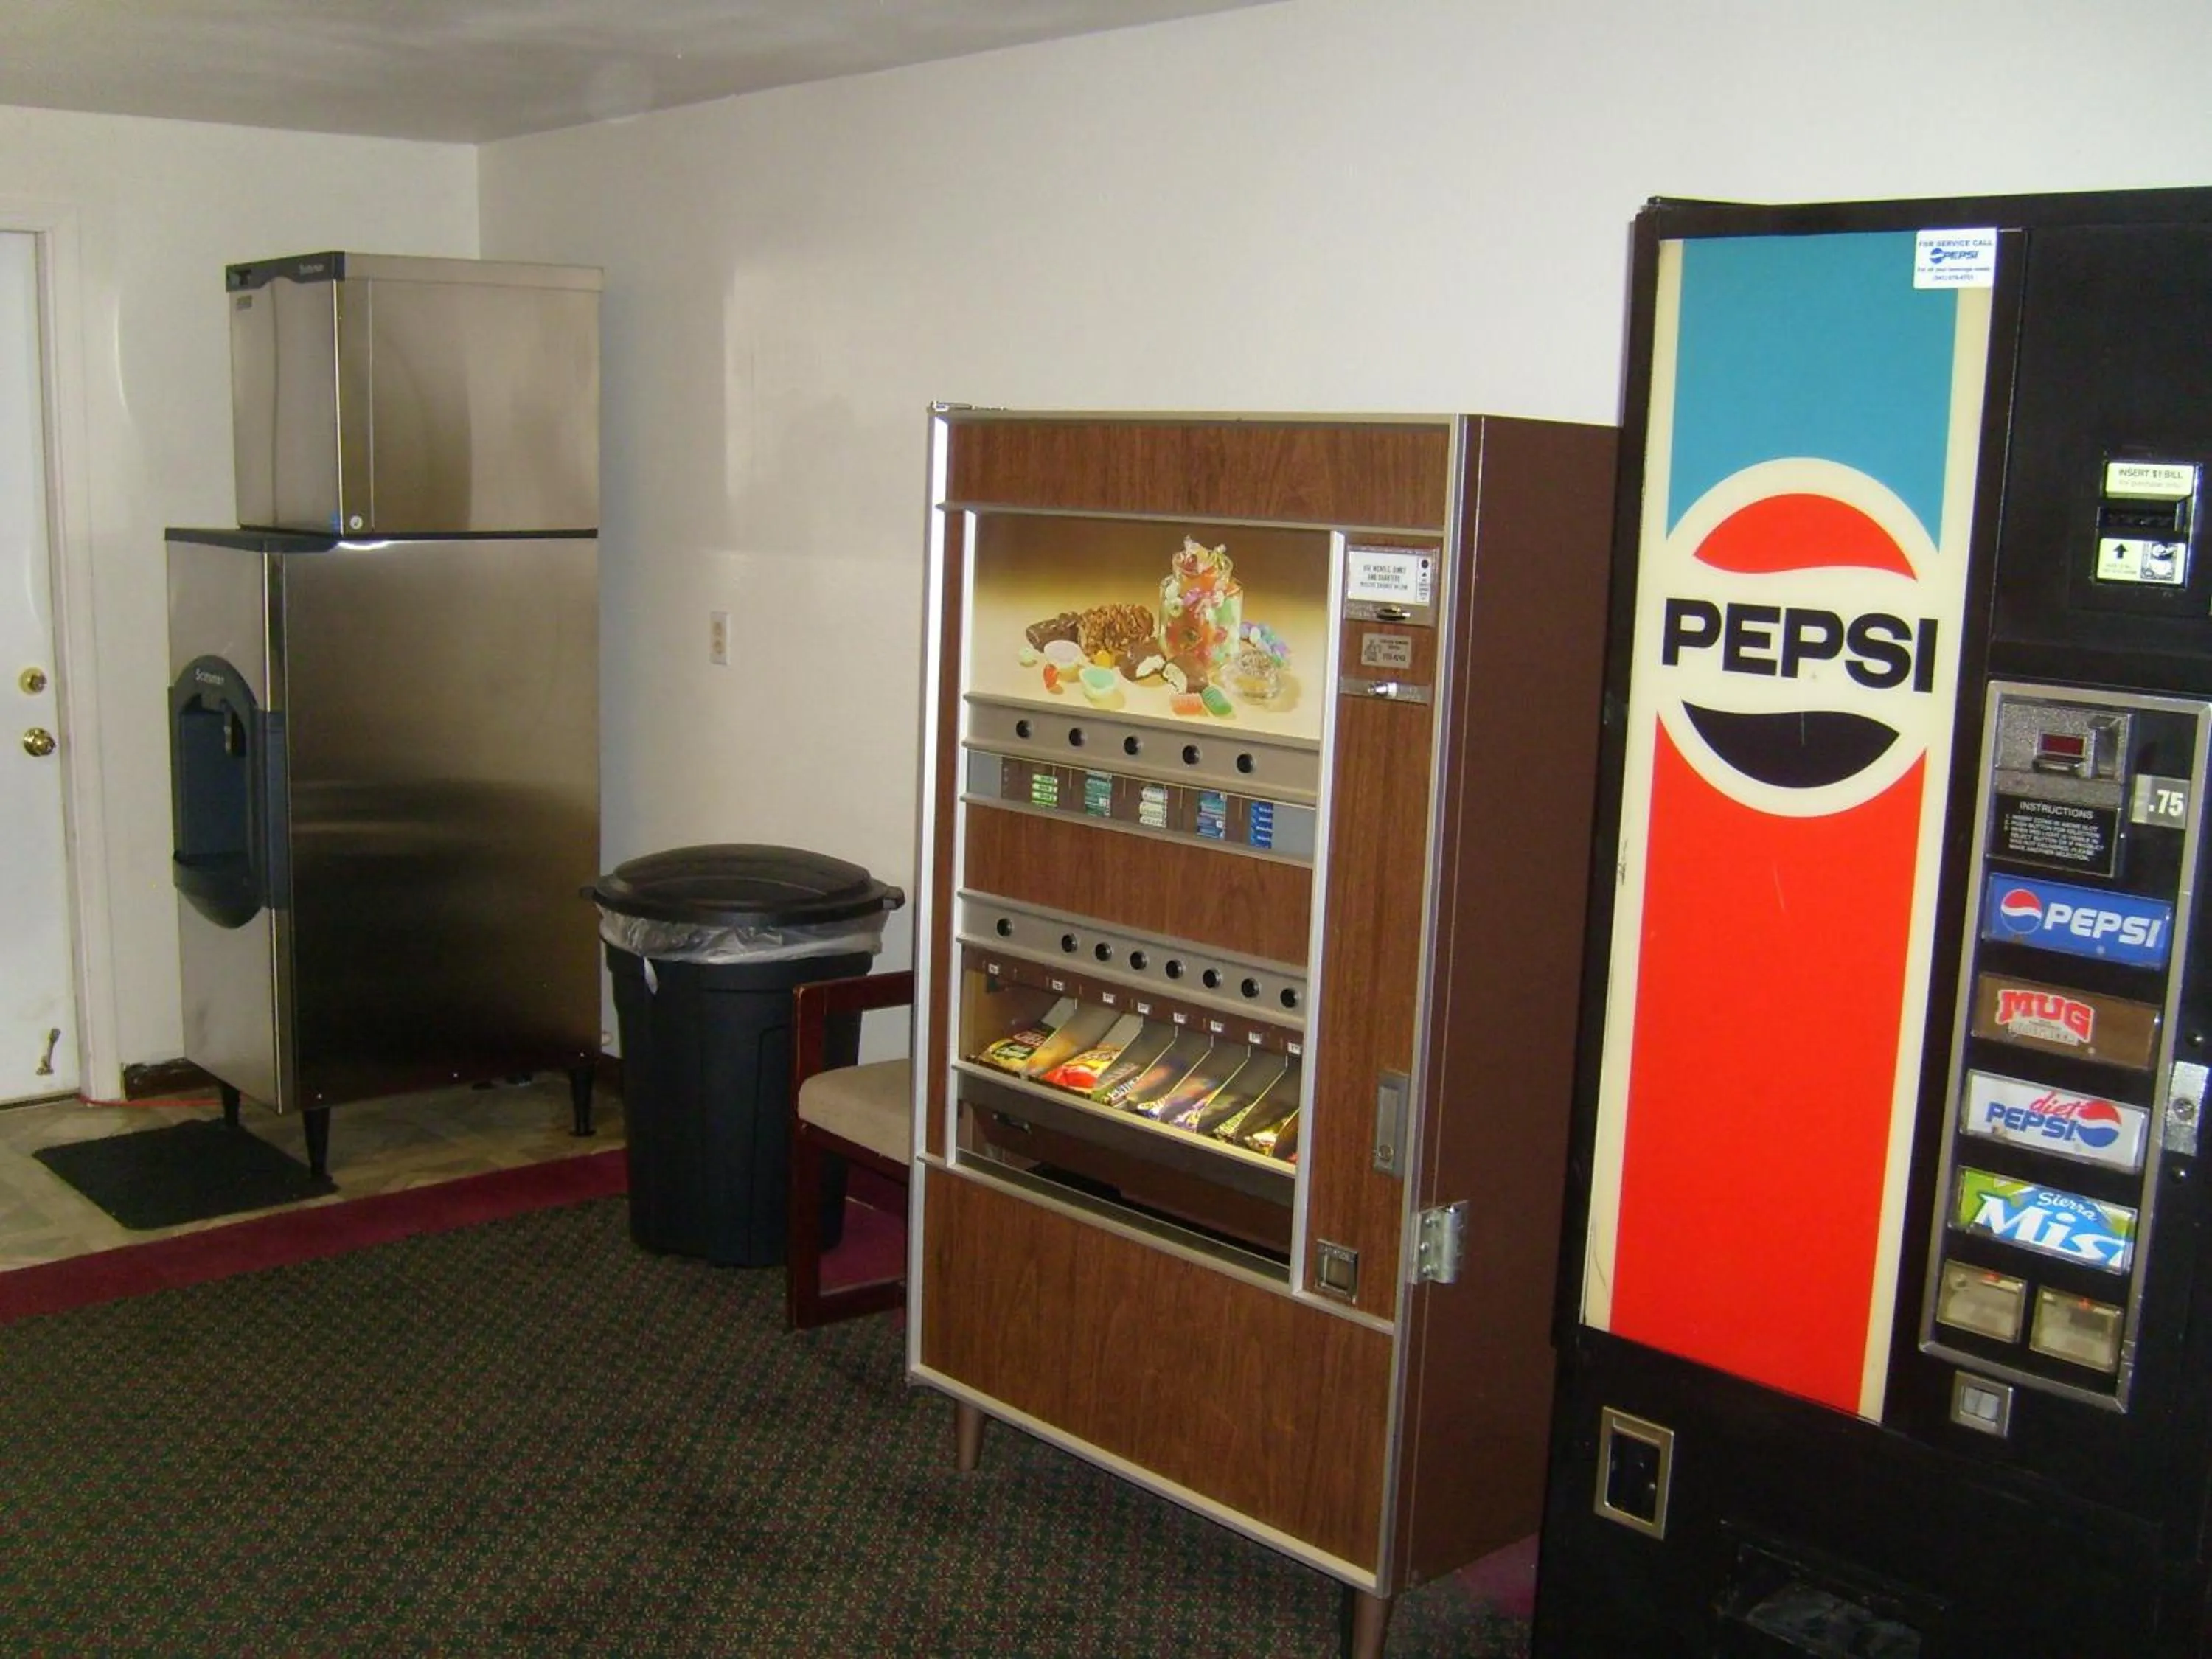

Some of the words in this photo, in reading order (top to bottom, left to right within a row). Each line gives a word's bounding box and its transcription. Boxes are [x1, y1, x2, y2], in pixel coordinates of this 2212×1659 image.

[2118, 468, 2149, 478] INSERT
[2164, 471, 2183, 479] BILL
[1662, 597, 1938, 693] PEPSI
[2020, 801, 2094, 820] INSTRUCTIONS
[2148, 790, 2183, 817] .75
[2044, 902, 2162, 948] PEPSI
[1995, 990, 2094, 1043] MUG
[2030, 1091, 2081, 1119] diet
[1986, 1102, 2078, 1141] PEPSI
[2037, 1192, 2098, 1221] Sierra
